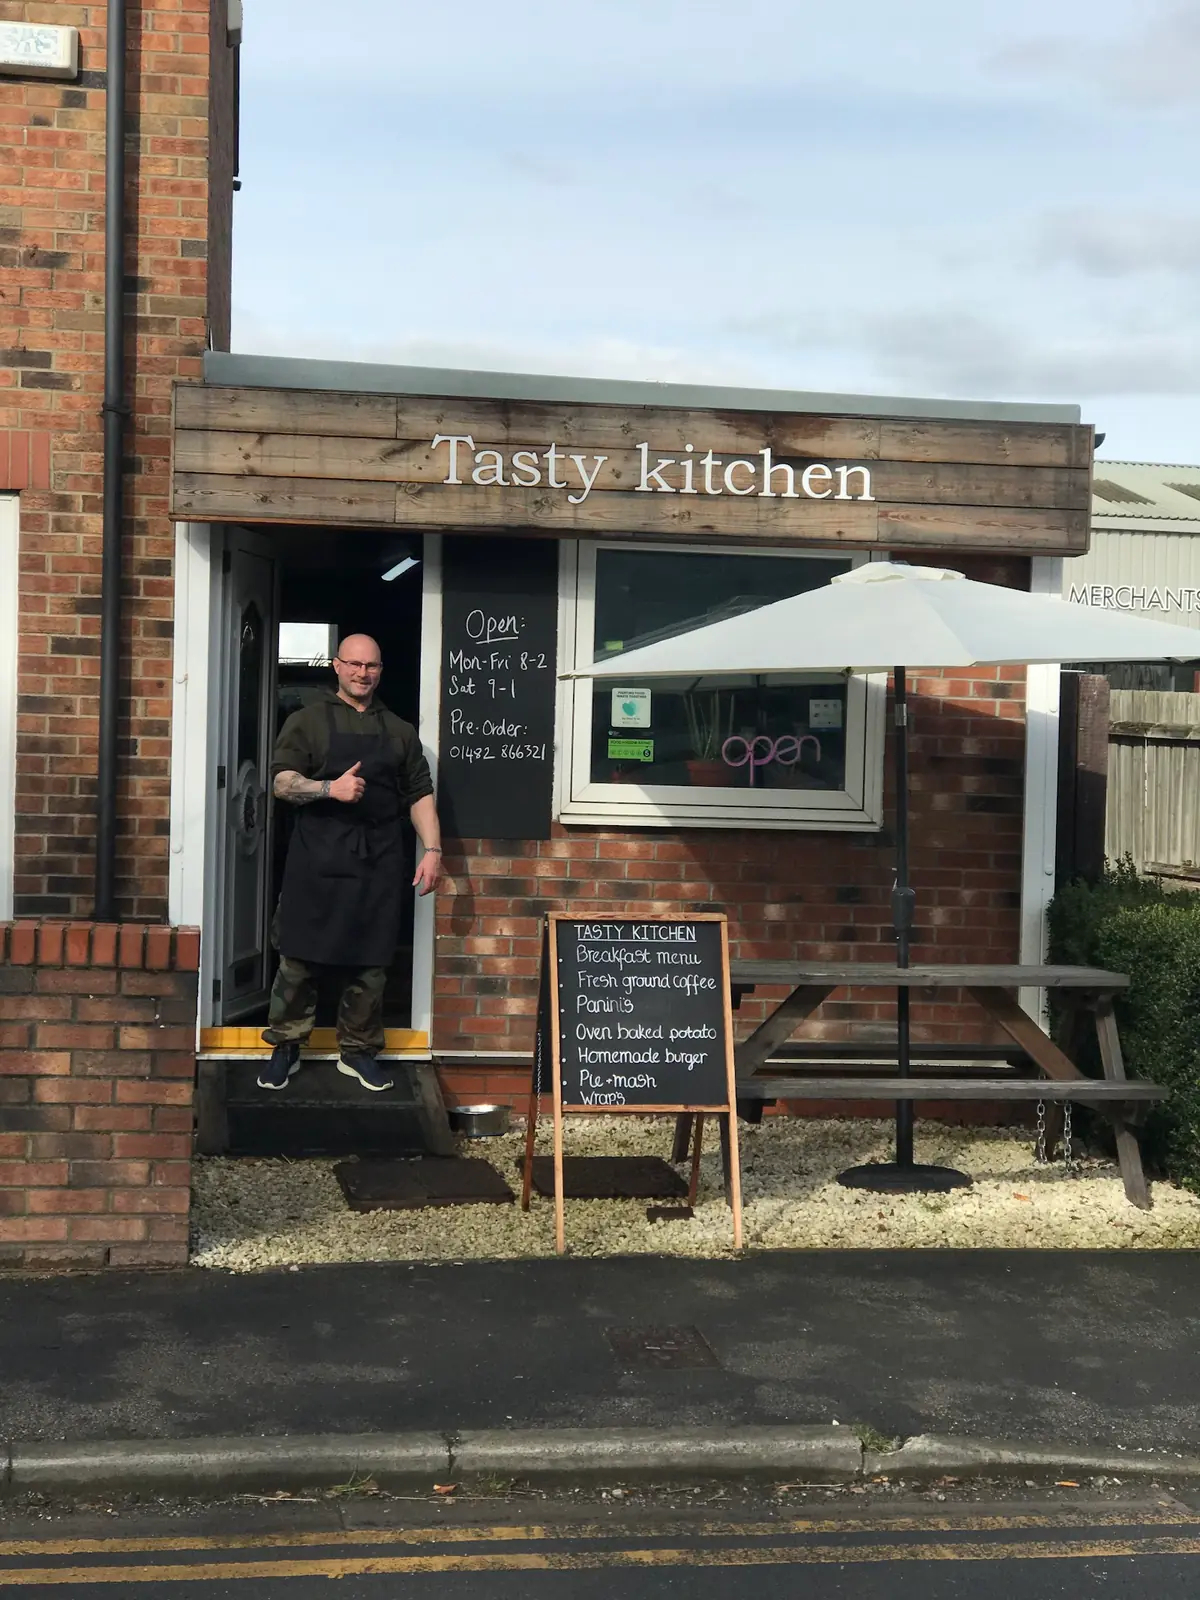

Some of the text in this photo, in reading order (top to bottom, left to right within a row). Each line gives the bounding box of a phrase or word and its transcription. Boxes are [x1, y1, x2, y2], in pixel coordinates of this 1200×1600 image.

[431, 434, 875, 503] Tasty kitchen
[466, 610, 525, 644] Open:
[450, 650, 547, 673] Mon-Fri 8-2
[449, 675, 515, 698] Sat 9-1
[450, 744, 545, 763] 01482 866321
[721, 735, 821, 786] open
[574, 925, 695, 940] TASTY KITCHEN
[577, 944, 701, 970] Breakfast menu
[578, 970, 716, 996] Fresh ground coffee
[576, 1022, 716, 1042] Oven baked potato
[578, 1047, 708, 1070] Homemade burger
[580, 1069, 603, 1088] Pie
